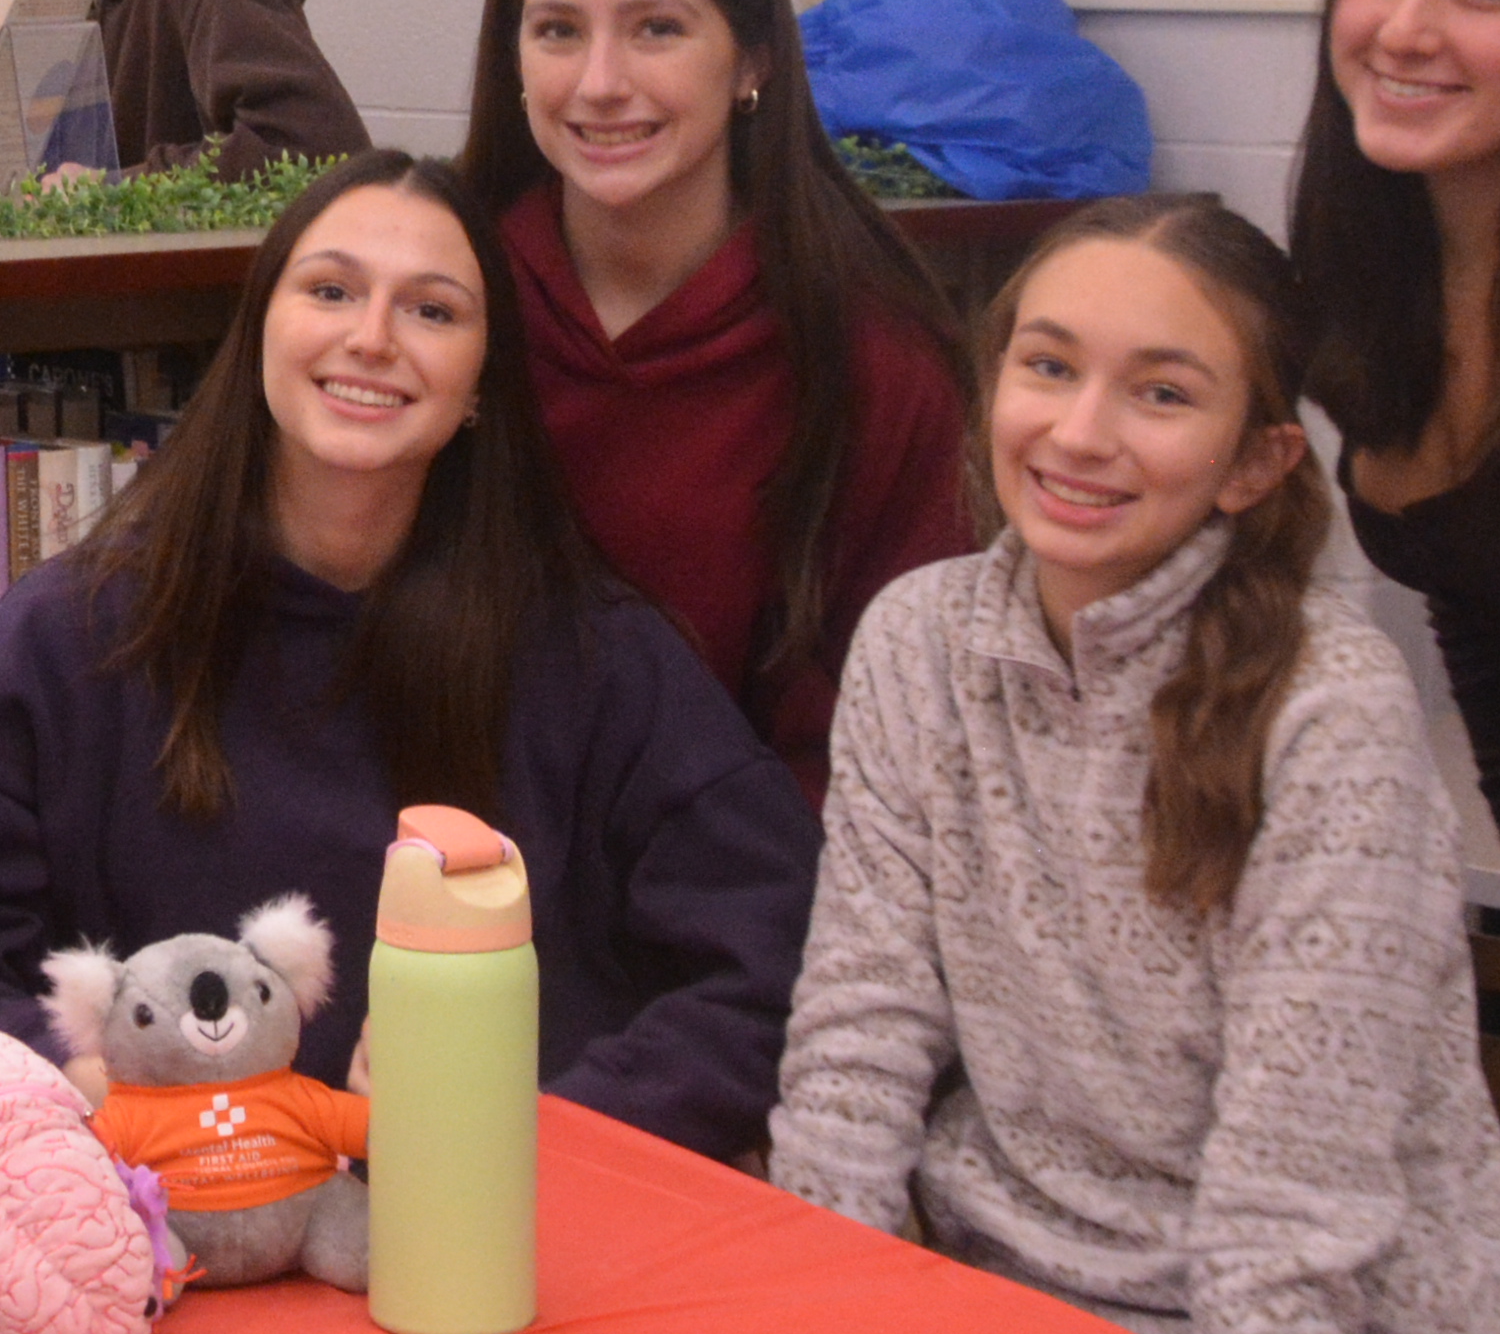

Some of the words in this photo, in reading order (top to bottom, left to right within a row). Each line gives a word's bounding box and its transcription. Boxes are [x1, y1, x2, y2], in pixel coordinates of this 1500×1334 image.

[232, 1133, 277, 1151] Health
[199, 1153, 234, 1166] FIRST
[239, 1151, 262, 1164] AID
